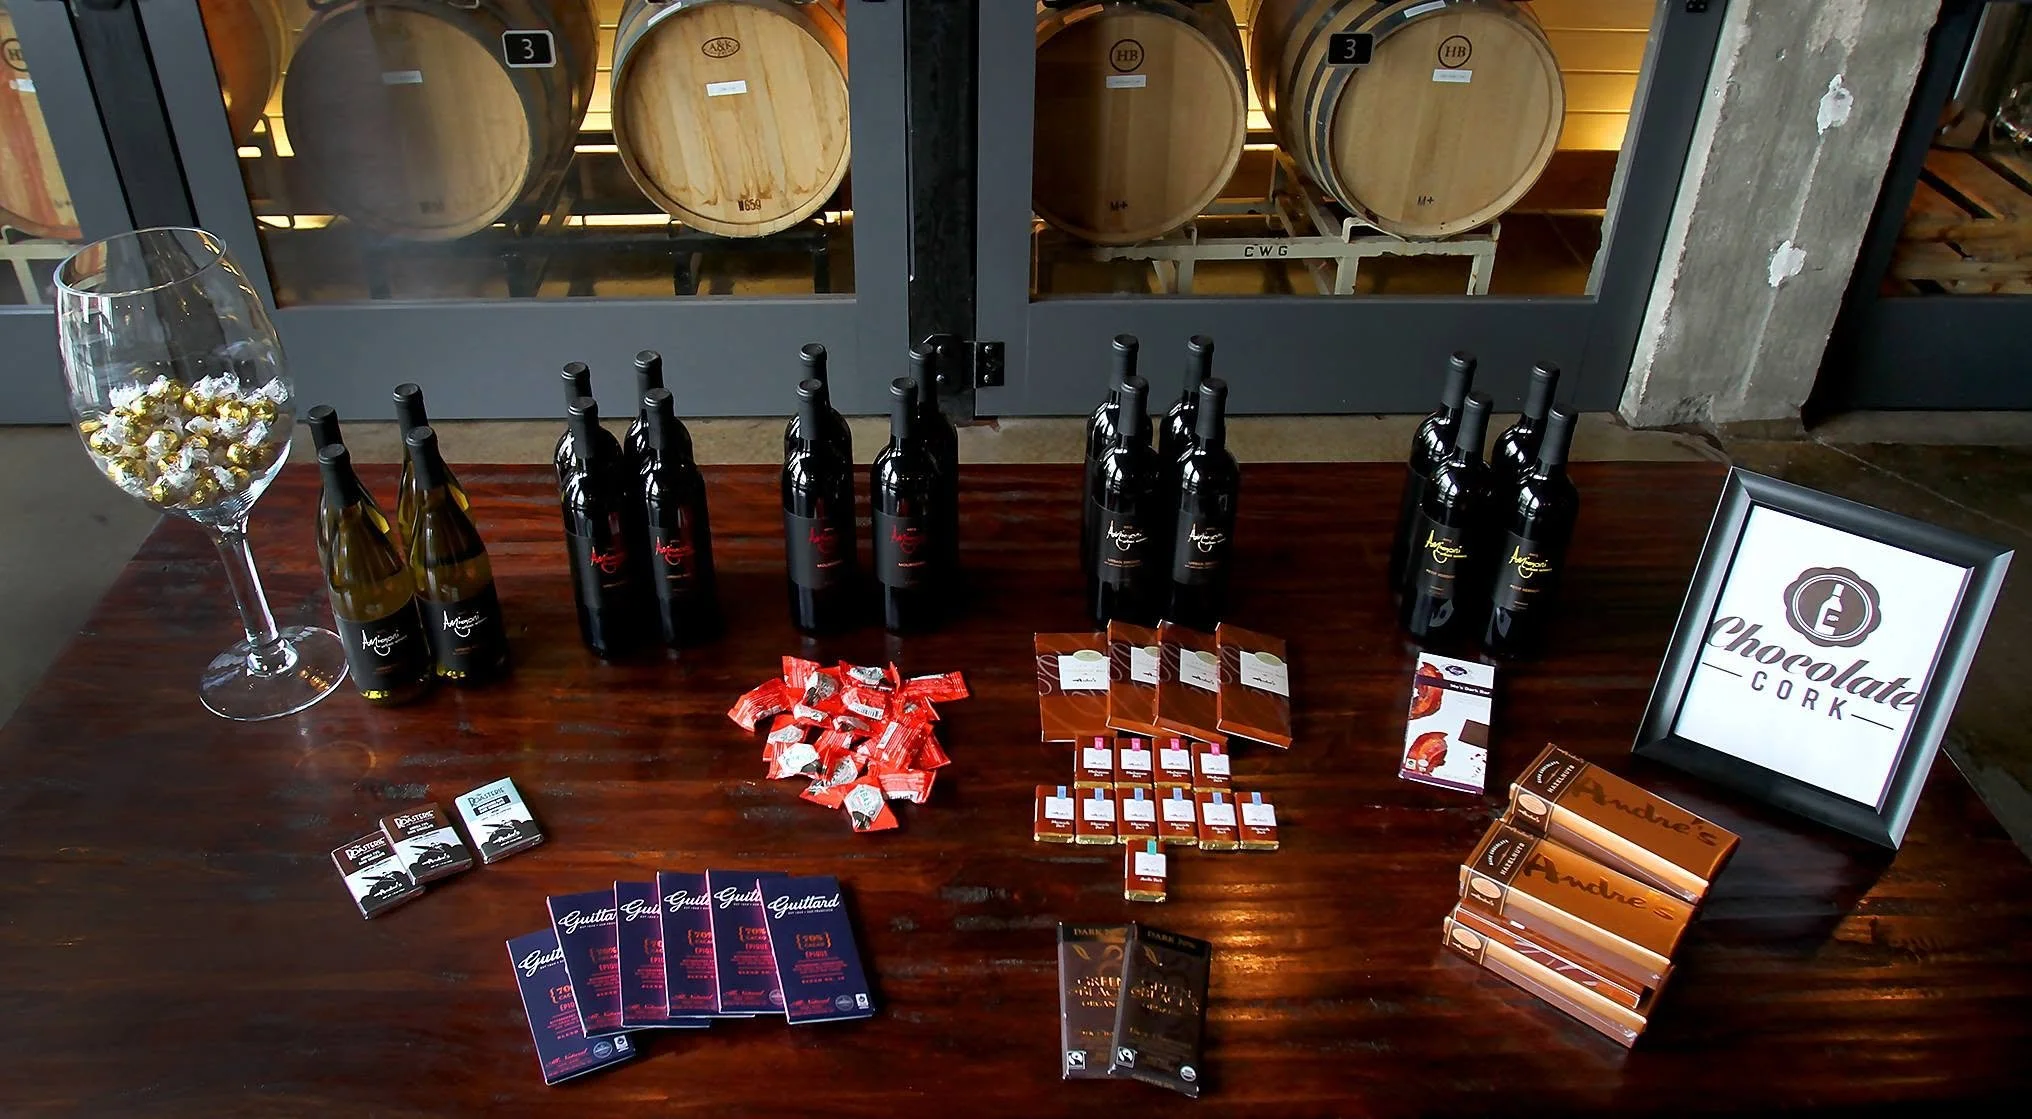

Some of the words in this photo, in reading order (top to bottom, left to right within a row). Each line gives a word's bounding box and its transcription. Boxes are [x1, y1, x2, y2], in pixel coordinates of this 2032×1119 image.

[521, 38, 535, 60] 3
[1116, 49, 1139, 61] HB
[1343, 38, 1357, 60] 3
[1444, 45, 1467, 58] HB
[1244, 245, 1288, 258] CWG
[1706, 616, 1922, 712] Chocolate
[1751, 670, 1848, 721] CORK
[1547, 764, 1576, 794] HAZELNUTS
[1500, 842, 1525, 876] HAZELNUTS
[663, 890, 711, 913] Guit
[714, 886, 762, 909] Guit
[767, 893, 841, 920] Guittard
[1147, 930, 1176, 945] DARK
[518, 946, 565, 978] Guit
